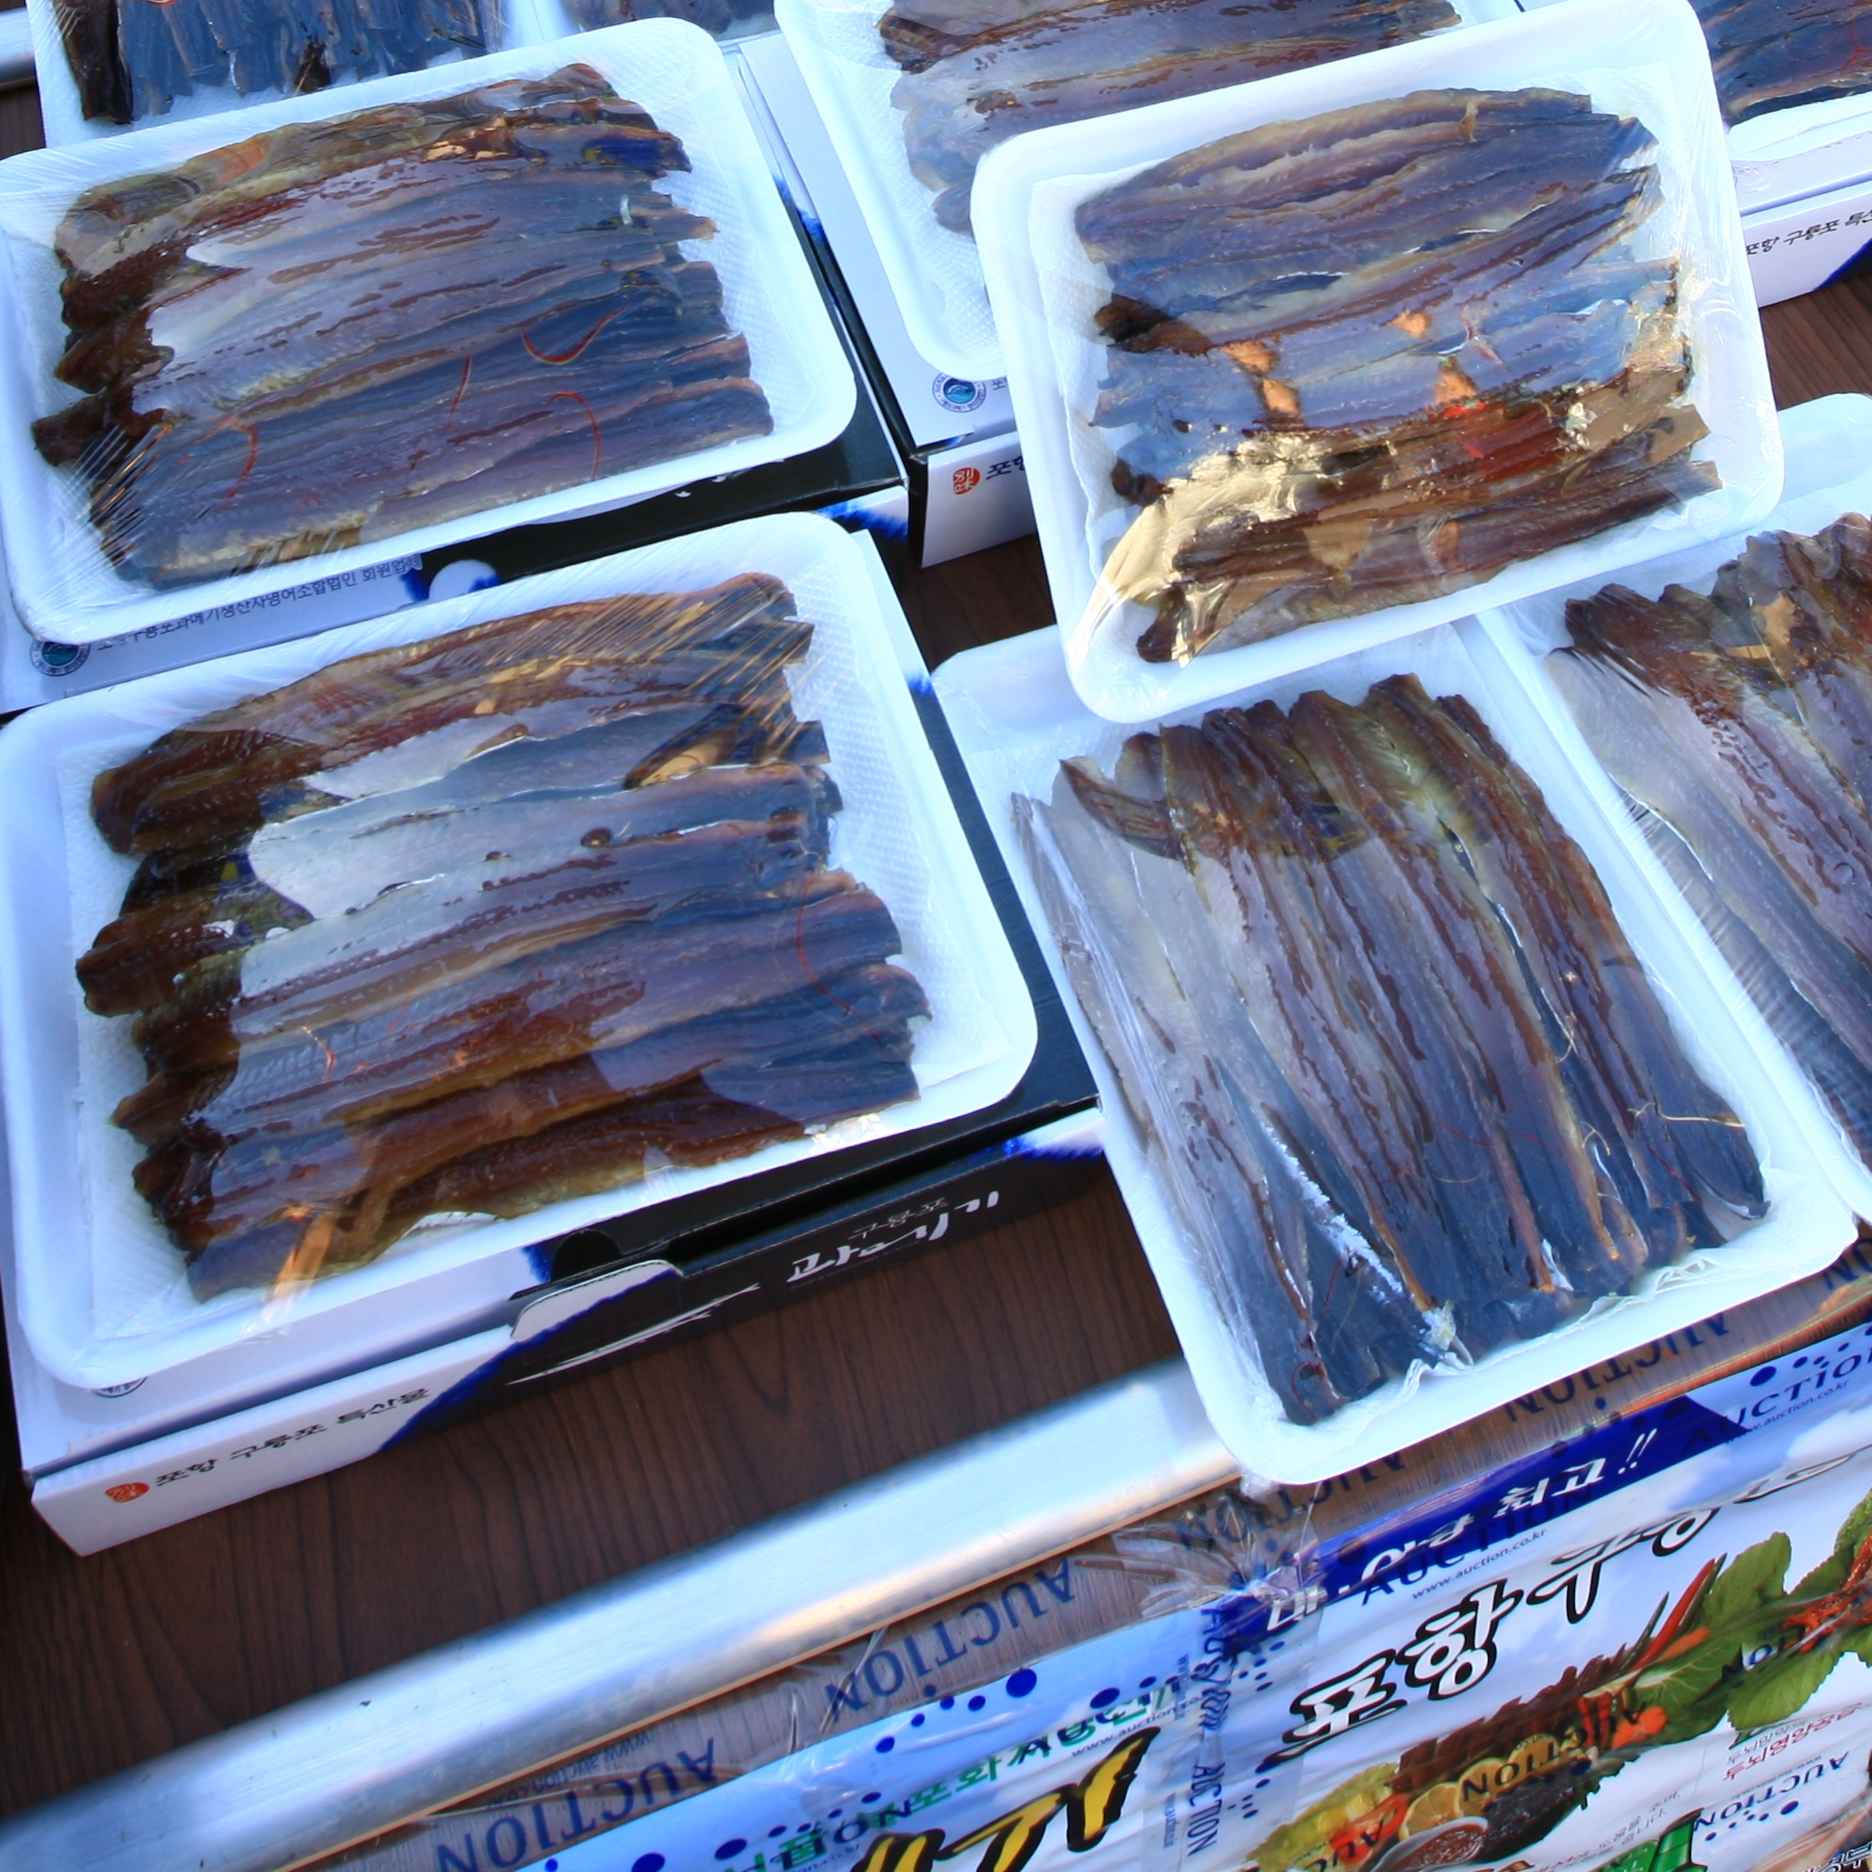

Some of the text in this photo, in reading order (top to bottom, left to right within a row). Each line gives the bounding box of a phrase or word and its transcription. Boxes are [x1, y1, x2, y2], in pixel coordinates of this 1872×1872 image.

[1783, 215, 1840, 247] 구룡포
[152, 1385, 431, 1492] 포항 구룡포 특산물
[824, 1555, 1078, 1725] AUCTION
